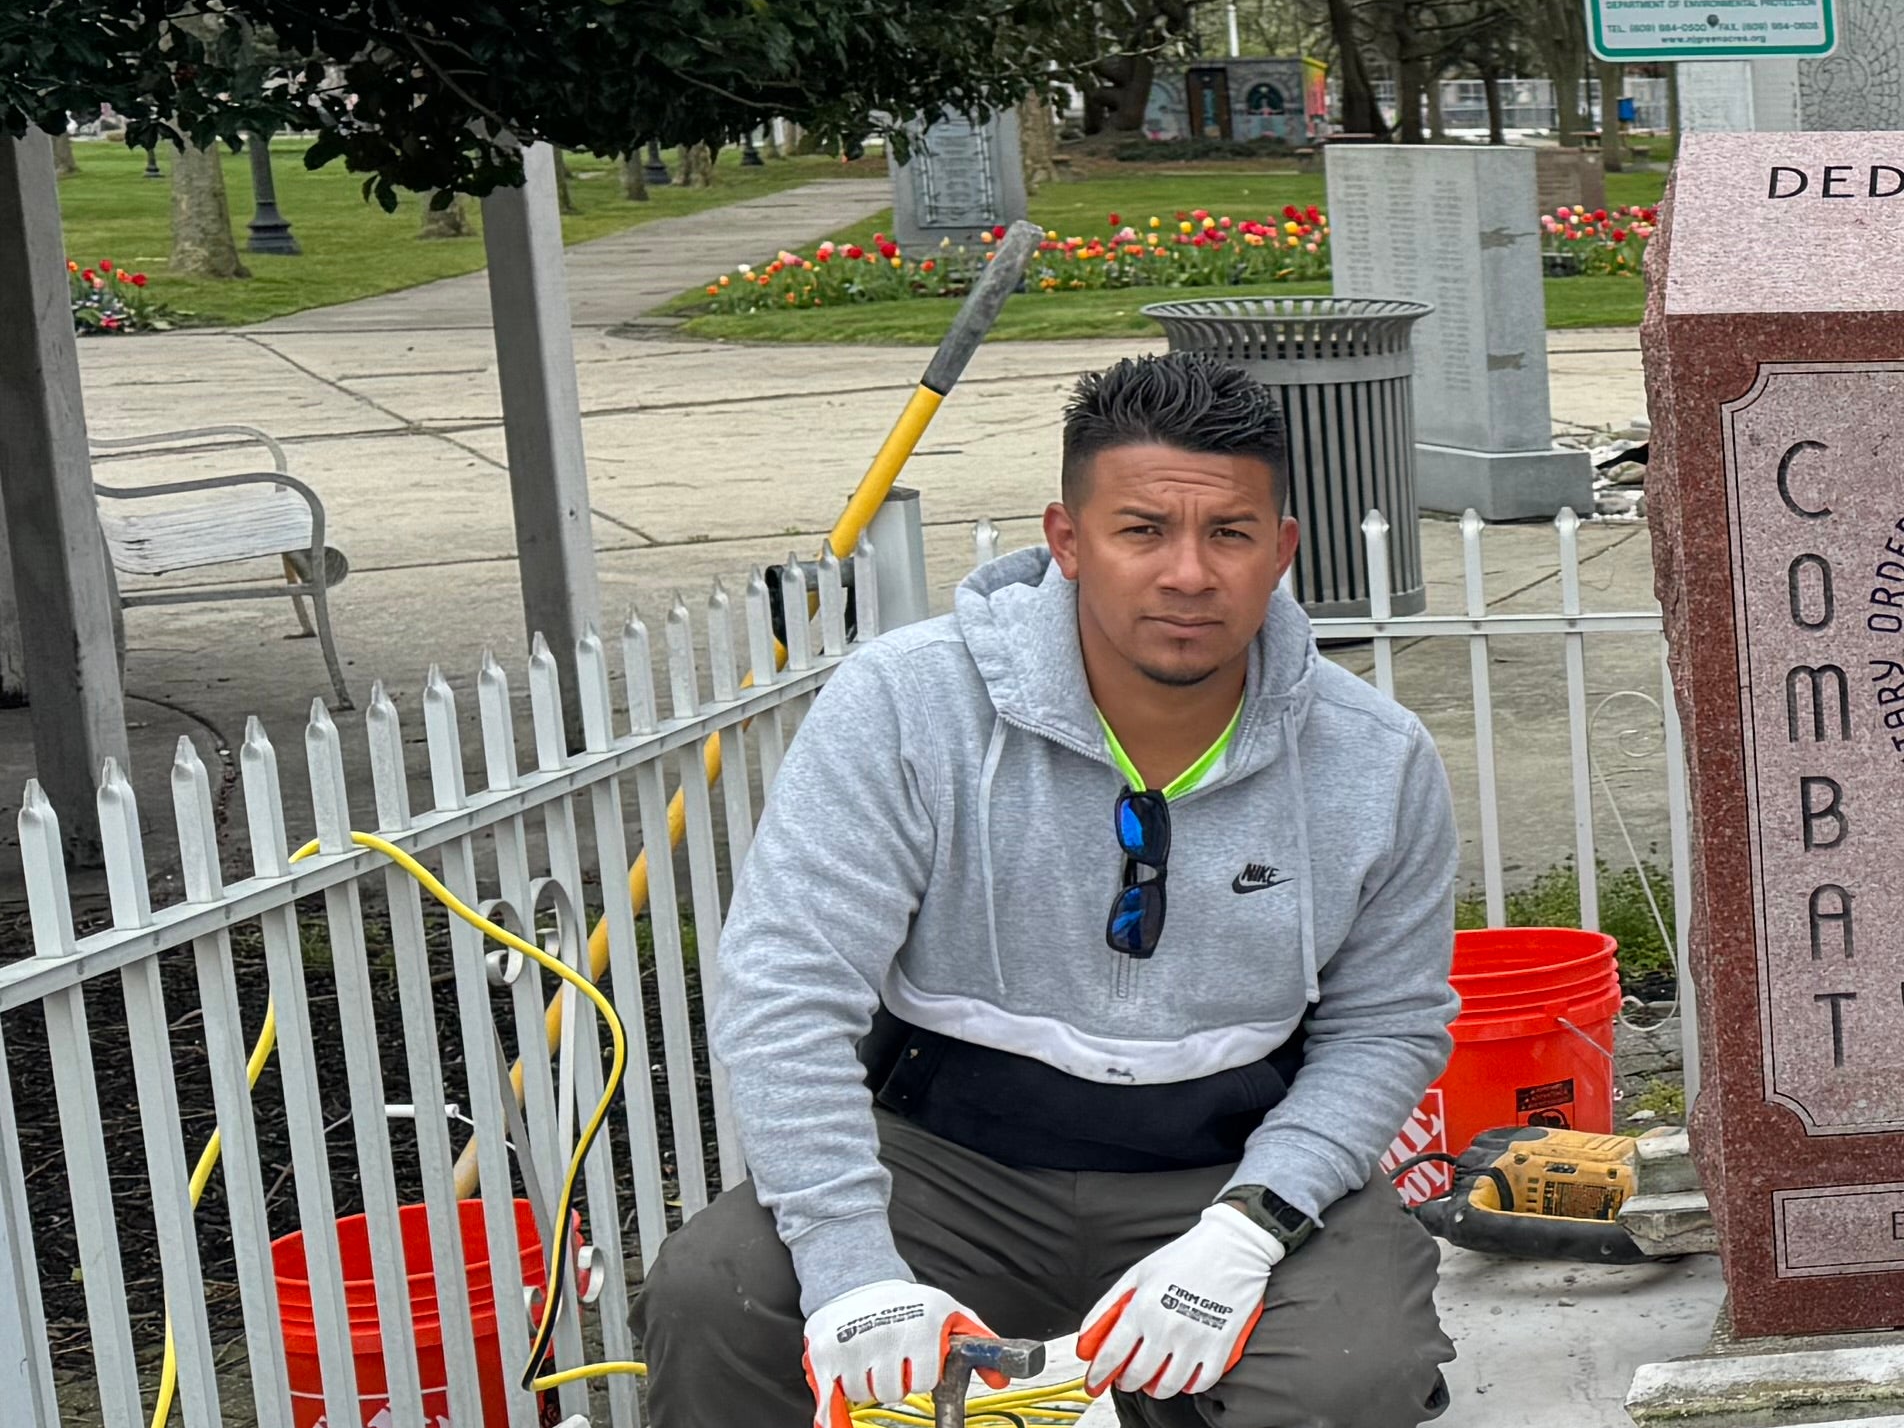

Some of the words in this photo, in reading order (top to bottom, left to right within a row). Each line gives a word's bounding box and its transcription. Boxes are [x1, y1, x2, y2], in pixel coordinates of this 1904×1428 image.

[1606, 0, 1665, 9] DEPARTMENT
[1668, 0, 1680, 8] OF
[1684, 0, 1757, 8] ENVIRONMENTAL
[1776, 439, 1857, 1070] COMBAT
[1241, 862, 1281, 885] NIKE
[1168, 1283, 1200, 1305] FIRM
[1199, 1298, 1234, 1315] GRIP
